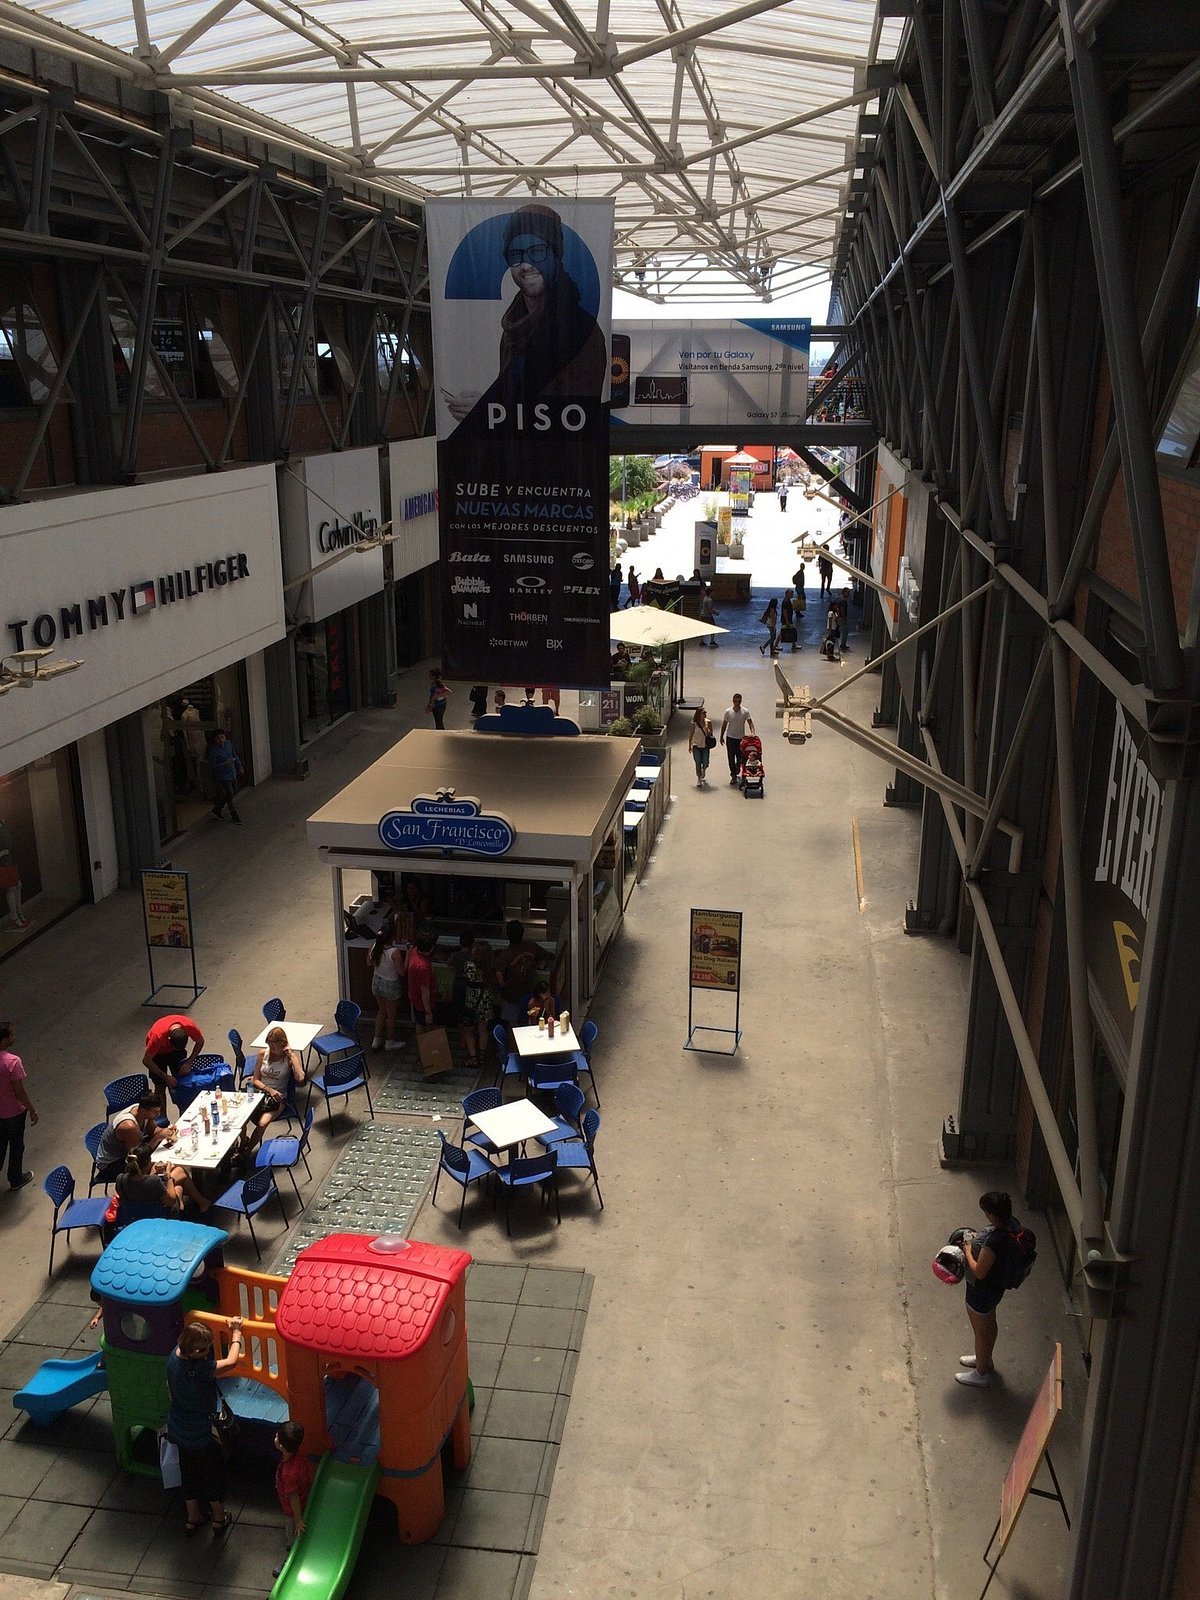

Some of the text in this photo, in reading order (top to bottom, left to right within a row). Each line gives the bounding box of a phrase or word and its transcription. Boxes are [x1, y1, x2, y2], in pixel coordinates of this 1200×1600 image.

[678, 351, 755, 361] Ven por tu Galaxy
[719, 363, 741, 371] tienda
[741, 363, 774, 372] Samsung,
[787, 363, 804, 371] nivel
[487, 402, 587, 432] PISO
[746, 411, 769, 419] Galaxy
[455, 483, 592, 498] SUBE Y ENCUENTRA
[455, 501, 594, 520] NUEVAS MARCAS
[483, 522, 529, 531] MEJORES
[532, 523, 599, 534] DESCUENTOS
[319, 518, 353, 553] Calvin
[448, 551, 492, 563] Bata
[503, 553, 555, 565] SAMSUNG
[454, 575, 486, 587] Bubble
[509, 587, 553, 595] OAKLEY
[571, 585, 601, 595] FLEX
[8, 552, 250, 652] TOMMY HILFIGER
[498, 639, 529, 648] GETWAY
[424, 806, 466, 814] LECHERIAS
[1095, 698, 1164, 923] EVER
[387, 818, 503, 841] San Francisco
